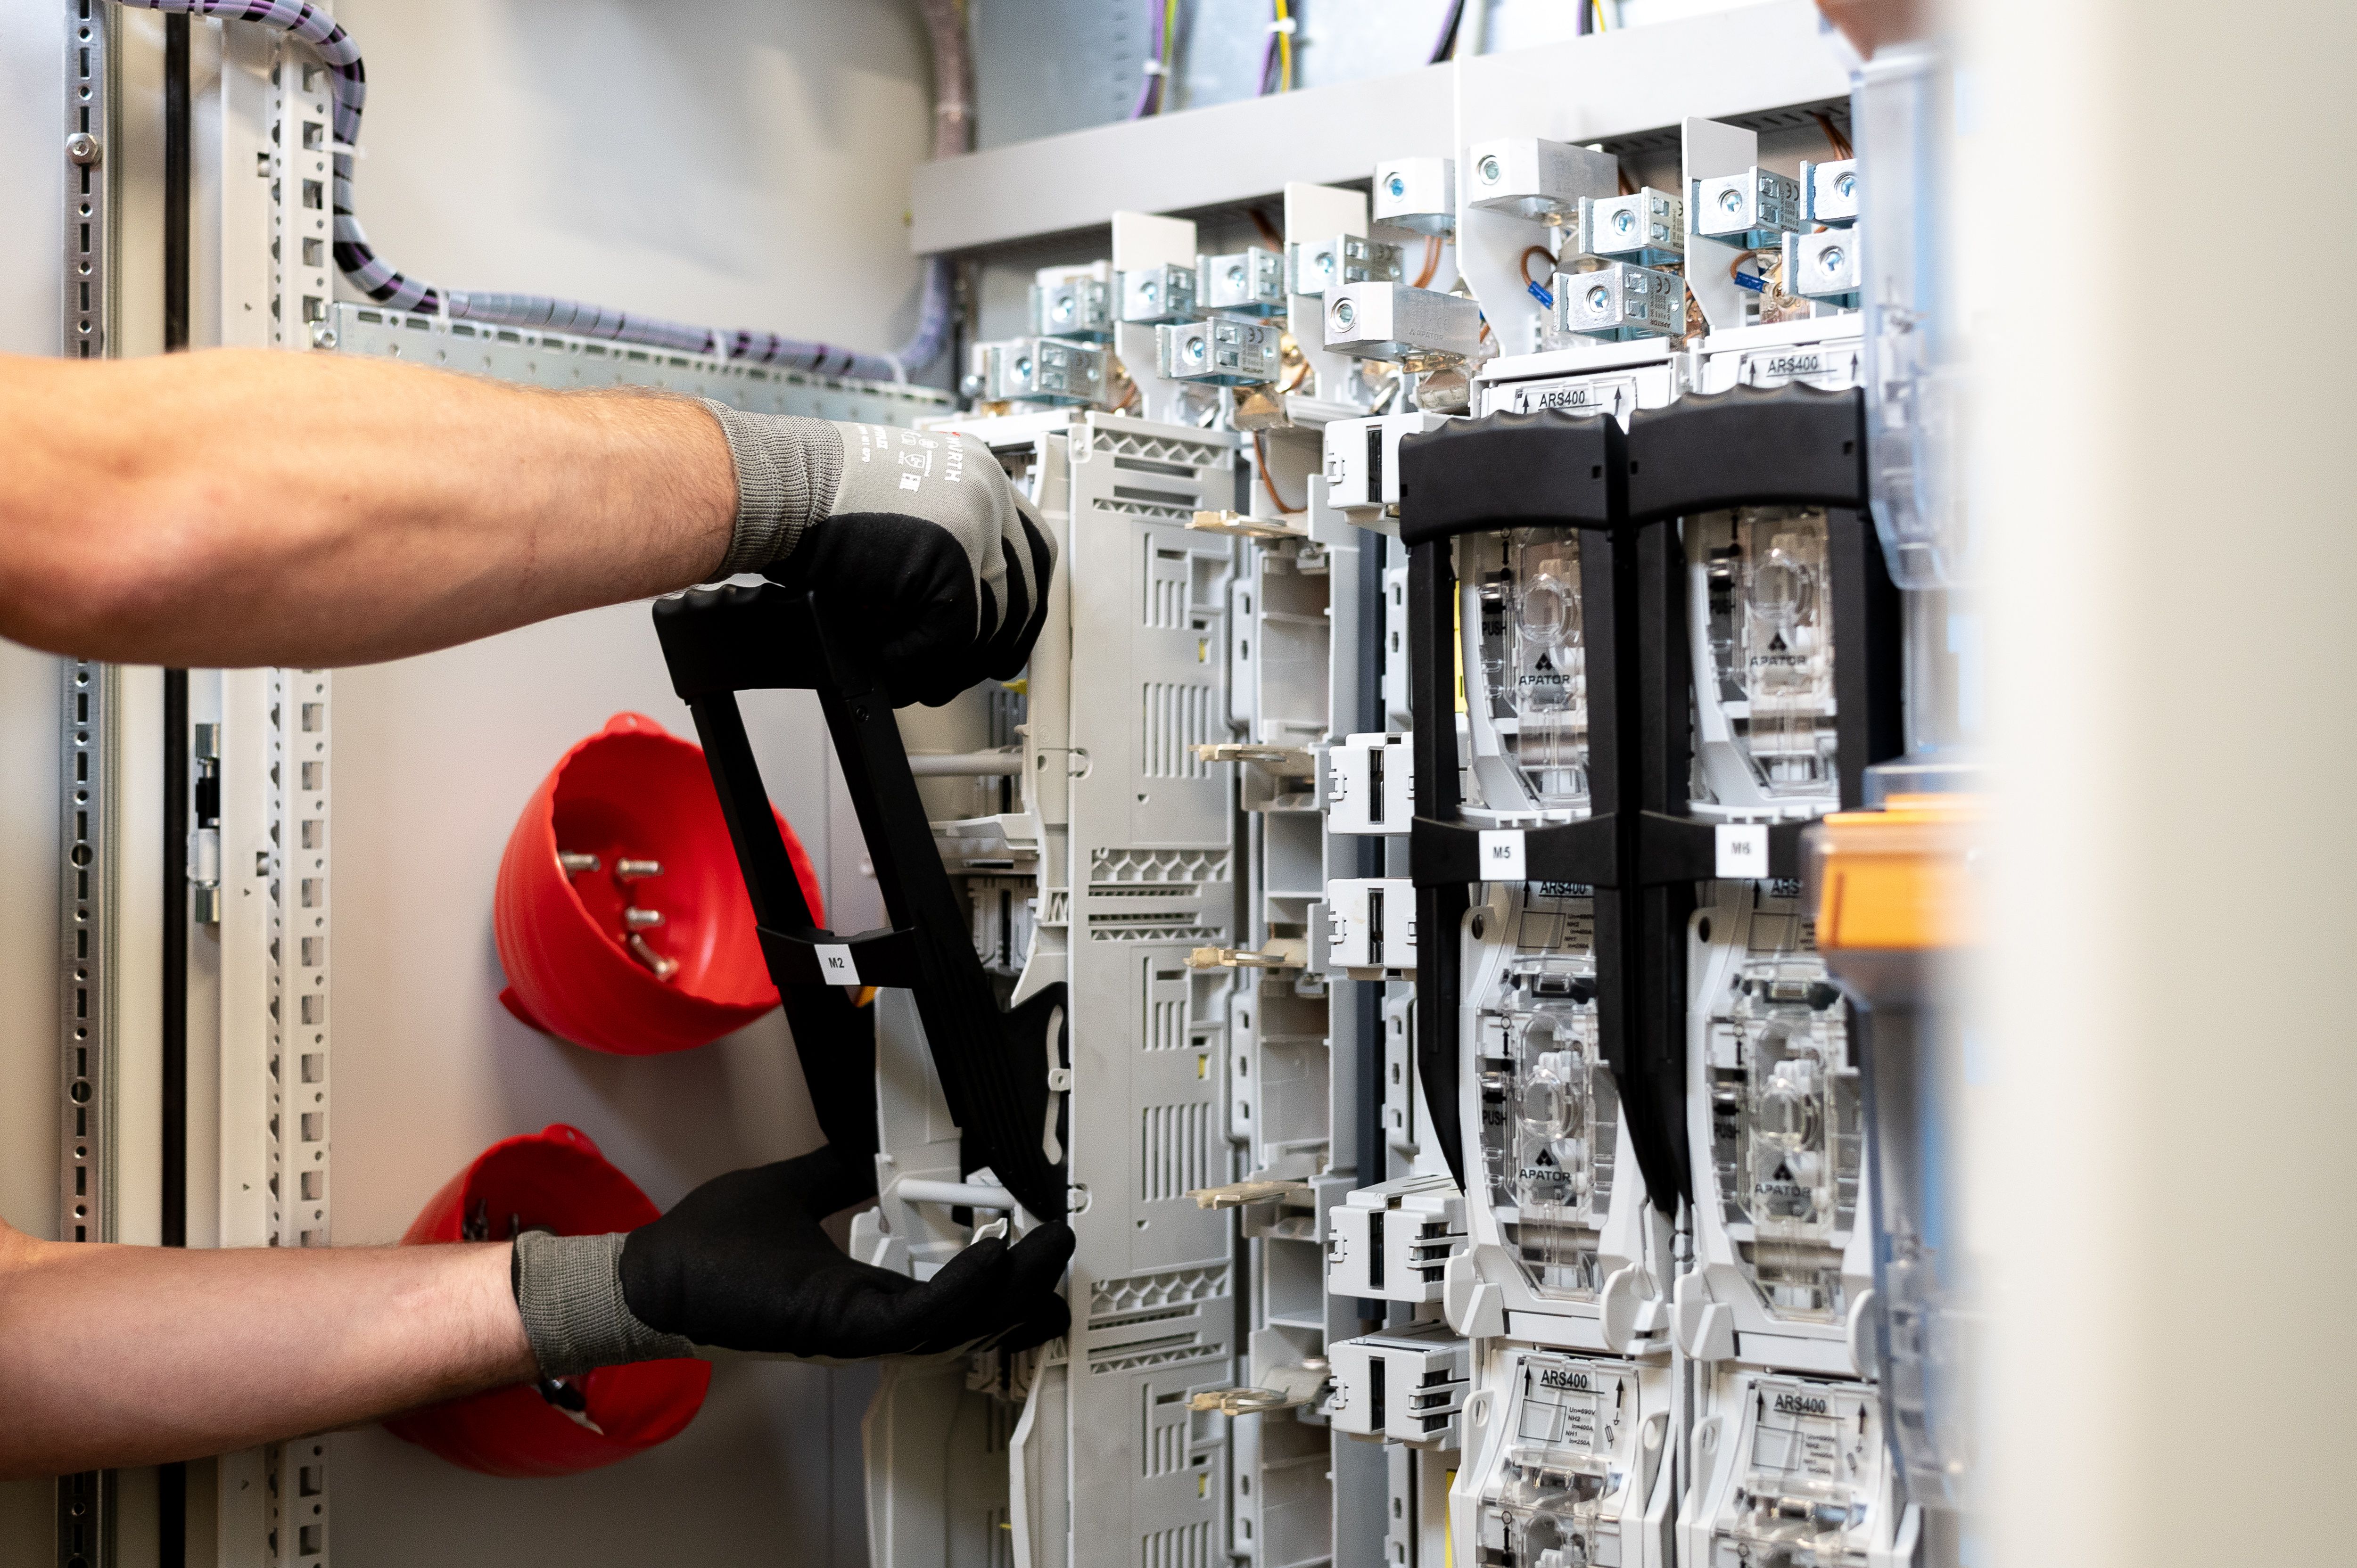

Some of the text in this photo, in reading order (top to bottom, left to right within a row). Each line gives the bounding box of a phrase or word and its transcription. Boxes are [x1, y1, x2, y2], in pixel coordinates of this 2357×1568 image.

[1767, 356, 1818, 373] ARS400
[1539, 390, 1585, 408] ARS400
[1751, 655, 1807, 666] APATOR
[1519, 674, 1570, 685] APATOR
[1493, 846, 1511, 859] M5
[1731, 842, 1751, 855] M6
[1540, 880, 1586, 895] ARS400
[828, 957, 845, 968] M2
[1519, 1168, 1571, 1182] APATOR
[1755, 1183, 1811, 1197] APATOR
[1541, 1369, 1587, 1389] ARS400
[1774, 1393, 1826, 1414] ARS400
